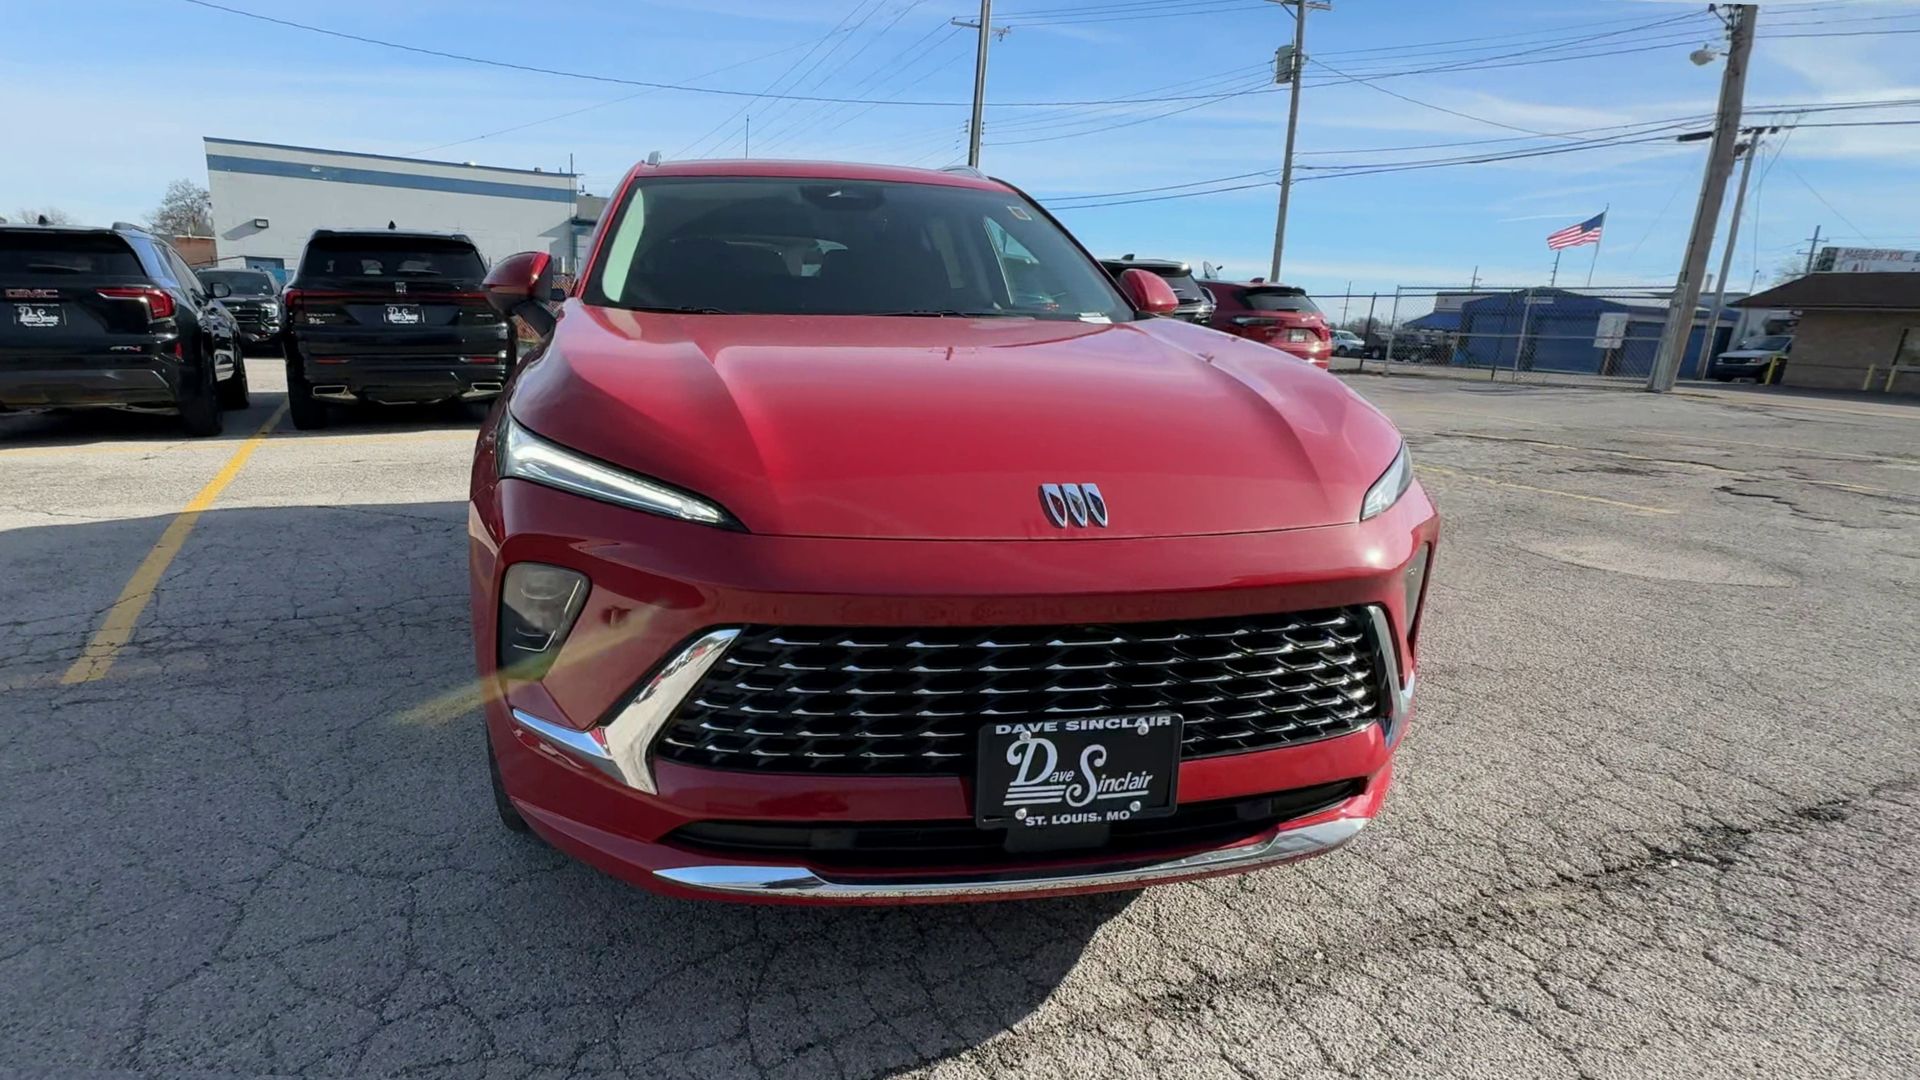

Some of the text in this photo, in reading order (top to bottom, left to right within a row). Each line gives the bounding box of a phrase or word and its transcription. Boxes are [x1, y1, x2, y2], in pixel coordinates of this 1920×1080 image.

[995, 715, 1172, 735] DAVE SINCLAIR
[1006, 737, 1154, 808] Dave Sinclair
[1025, 810, 1131, 827] ST. LOUIS, MO
